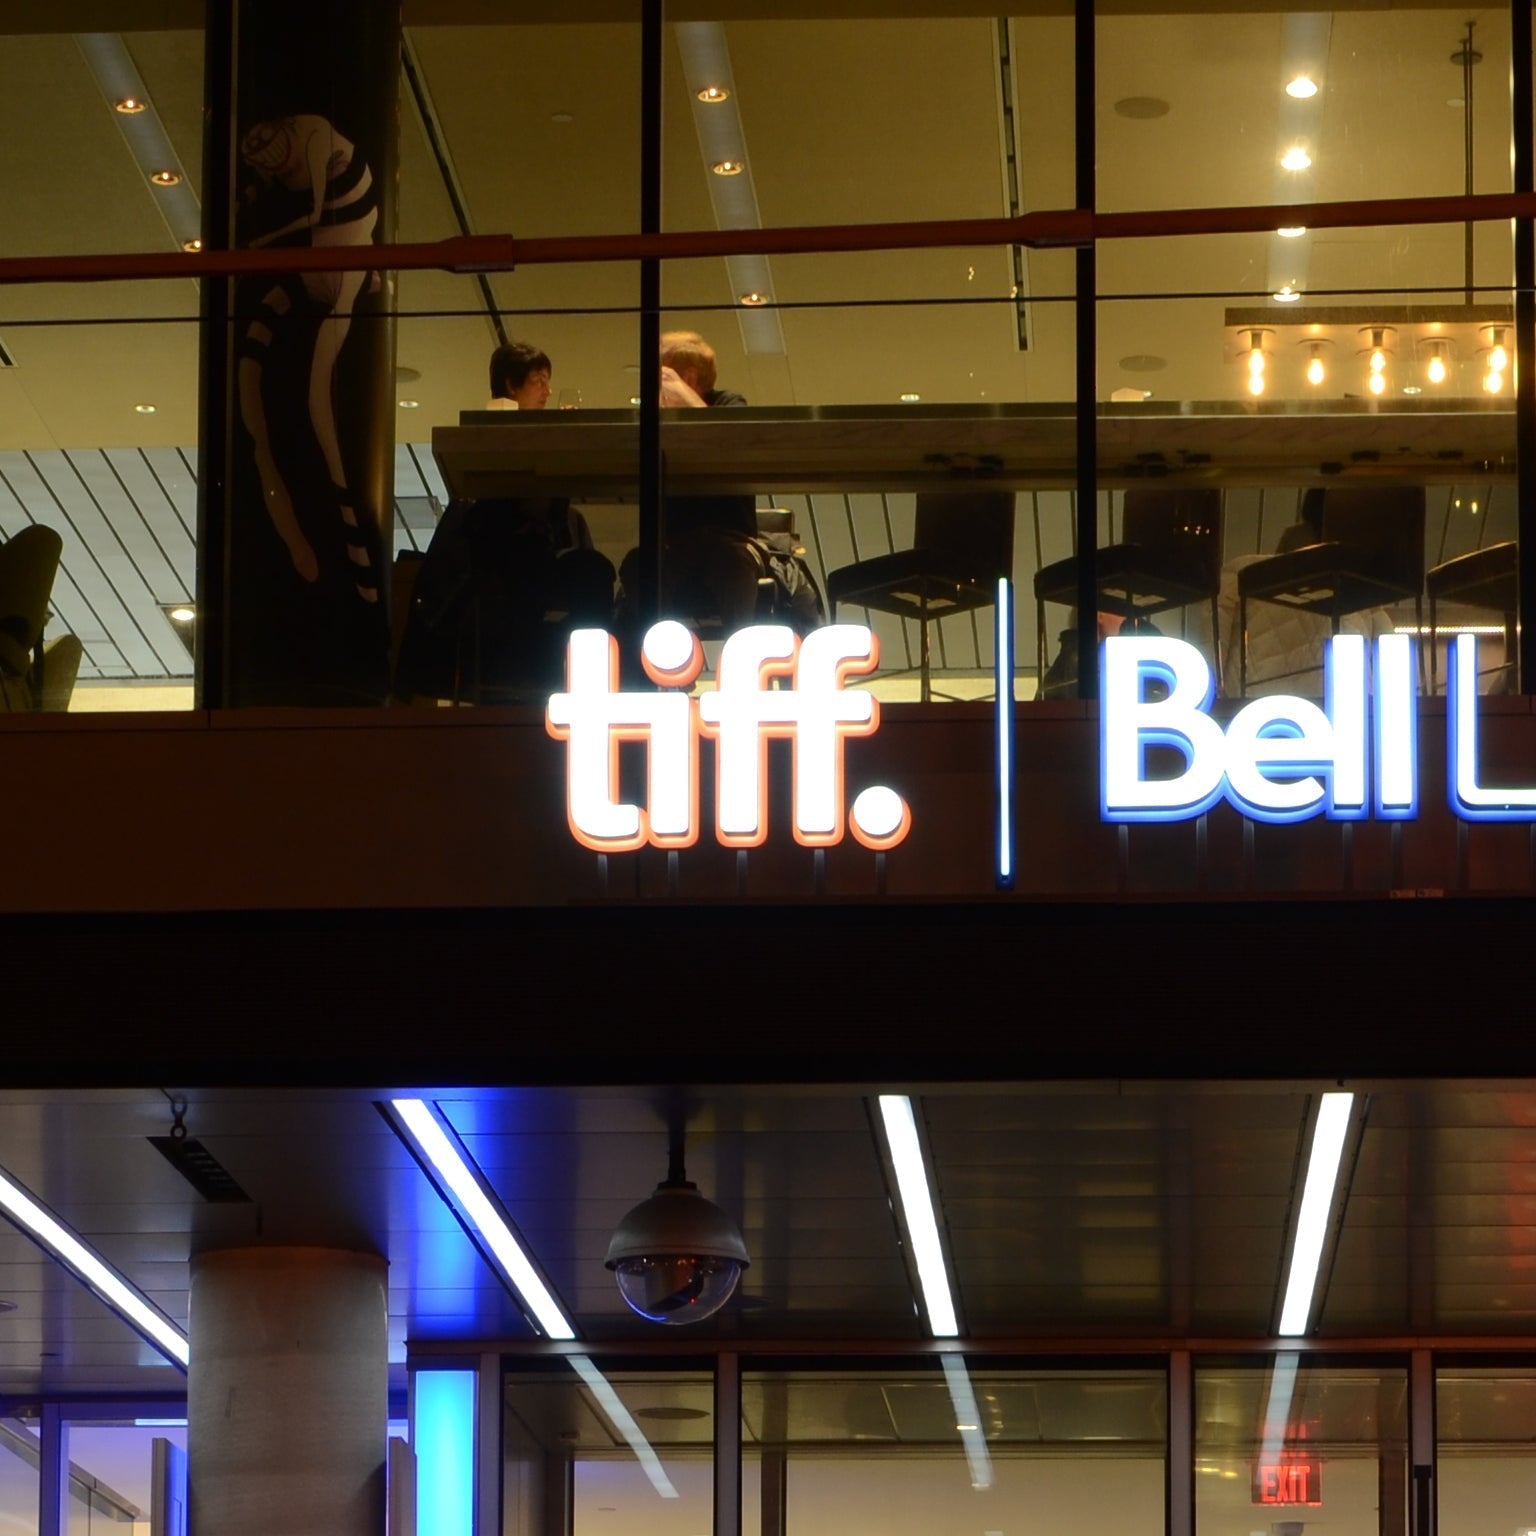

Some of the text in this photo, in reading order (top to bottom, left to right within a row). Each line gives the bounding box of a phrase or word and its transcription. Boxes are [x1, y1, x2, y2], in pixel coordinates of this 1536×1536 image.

[546, 617, 911, 852] tiff.
[1099, 633, 1418, 822] Bell
[1260, 1465, 1311, 1503] EXIT
